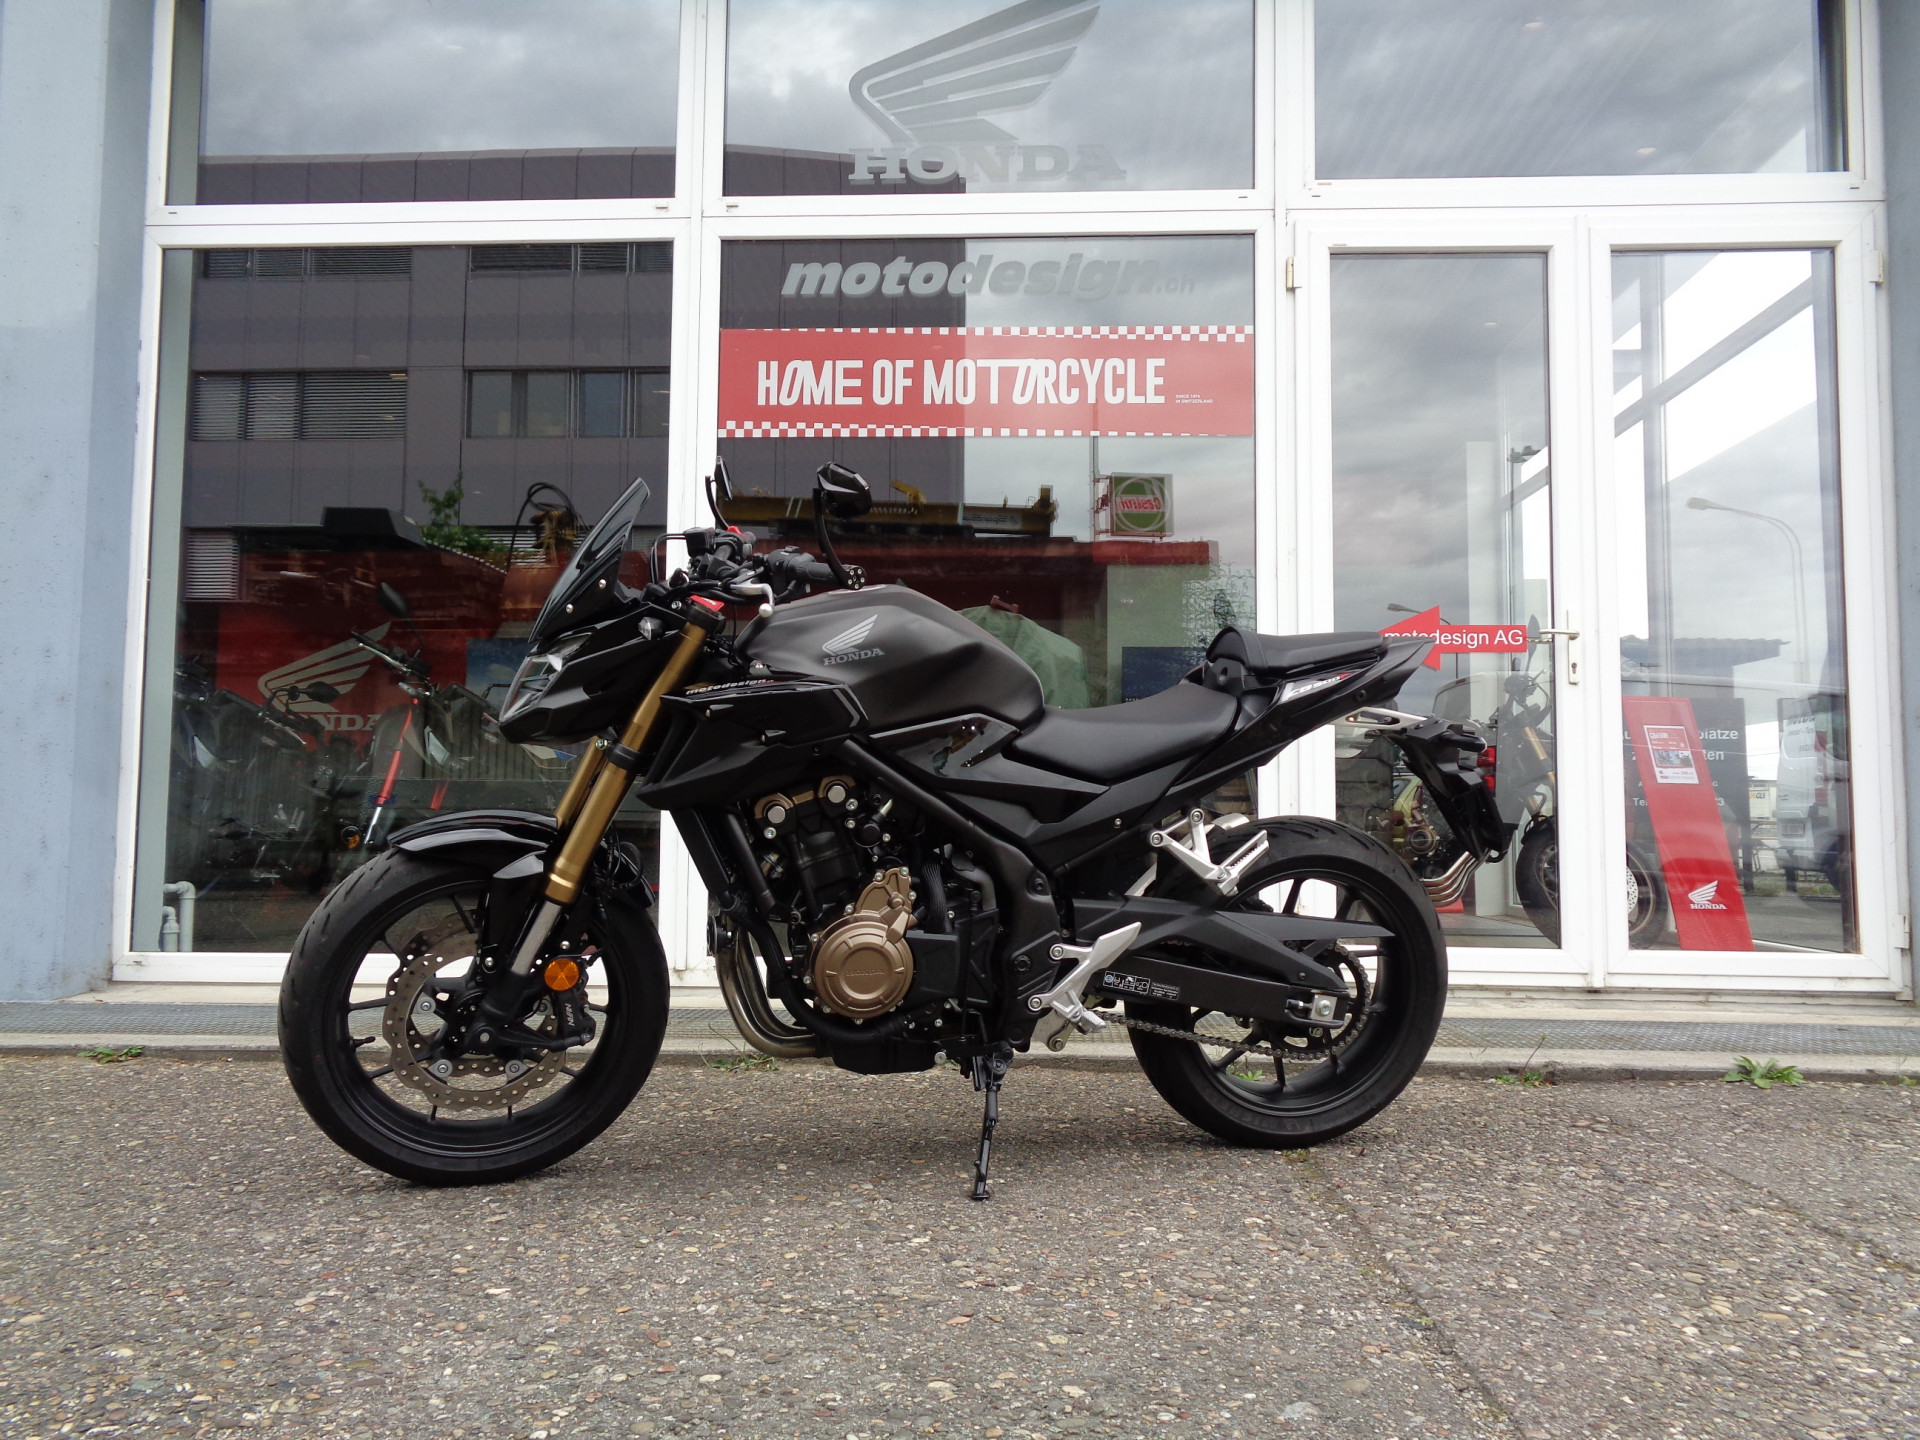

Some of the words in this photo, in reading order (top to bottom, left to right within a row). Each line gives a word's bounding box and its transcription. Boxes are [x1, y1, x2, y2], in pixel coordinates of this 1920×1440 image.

[848, 145, 1127, 184] HONDA
[757, 359, 864, 406] HOME
[872, 359, 914, 405] OF
[923, 358, 1166, 405] MOTORCYCLE
[1494, 630, 1524, 645] AG
[823, 647, 886, 666] HONDA
